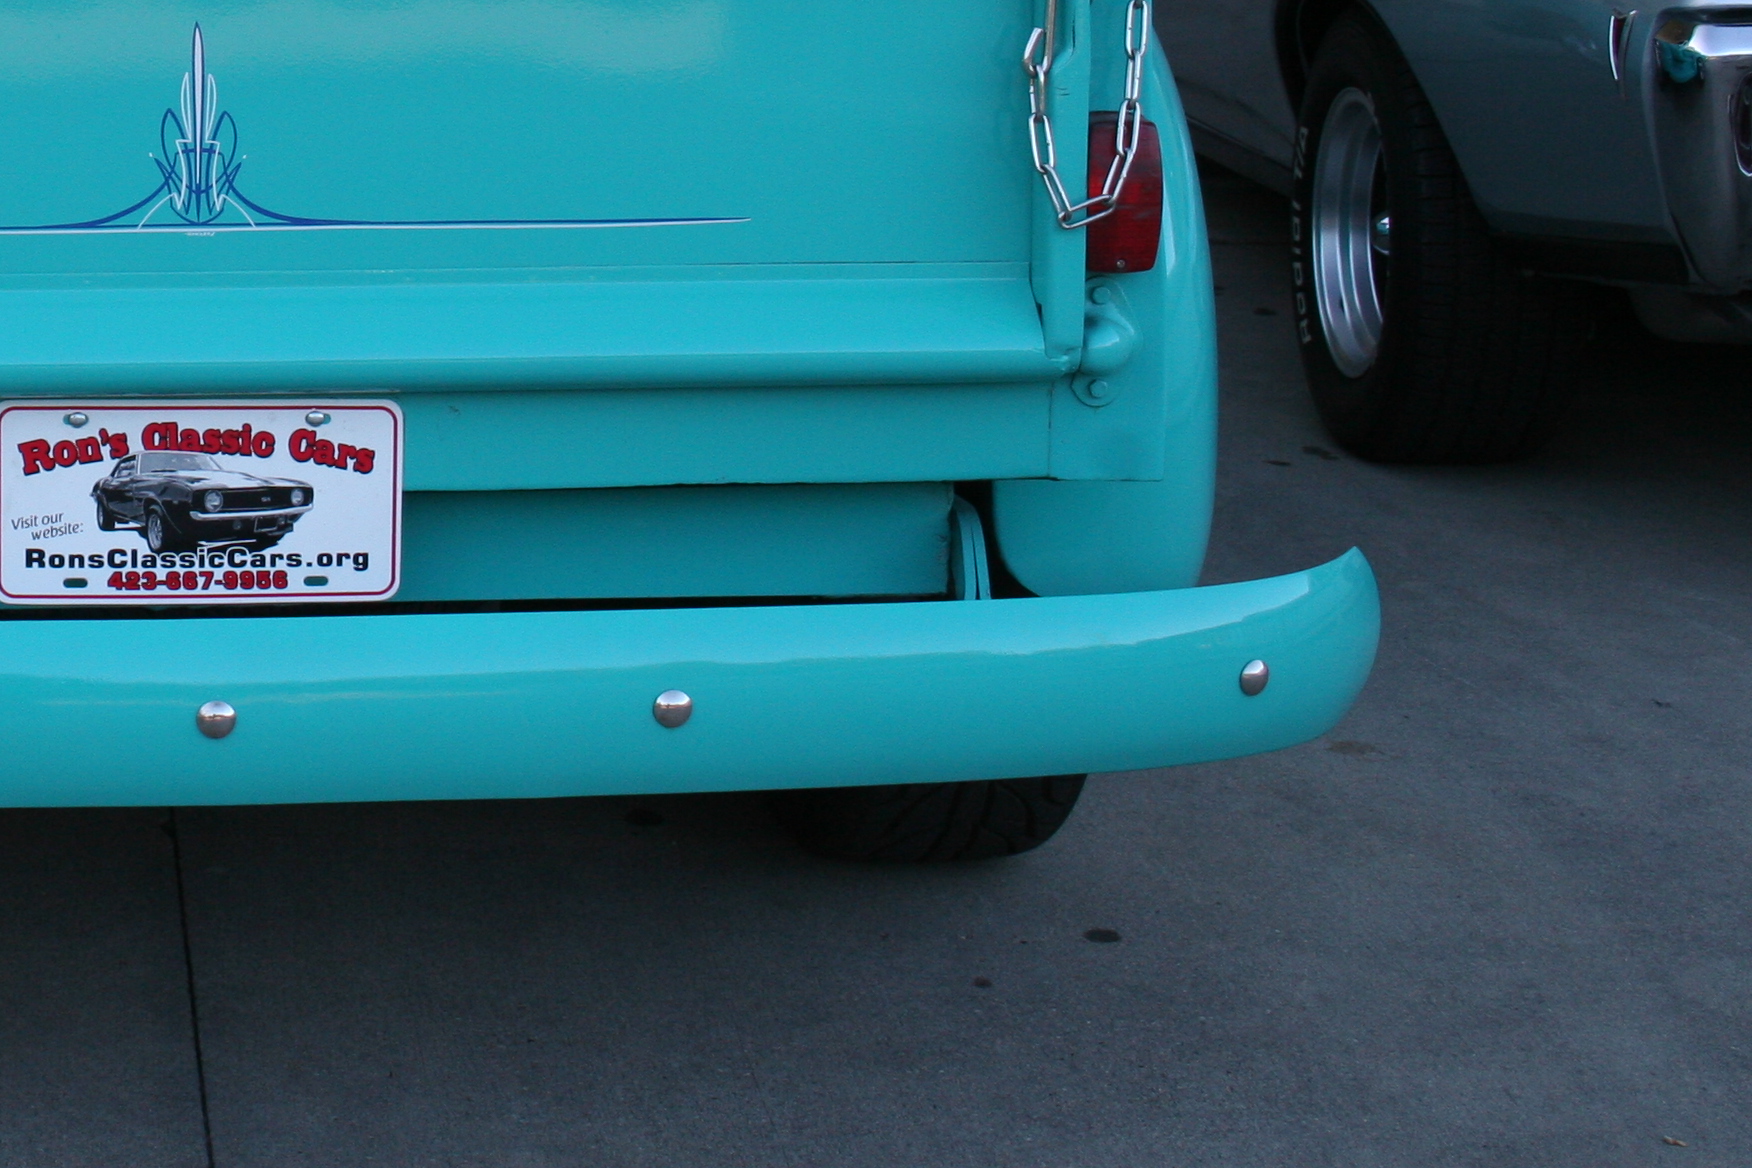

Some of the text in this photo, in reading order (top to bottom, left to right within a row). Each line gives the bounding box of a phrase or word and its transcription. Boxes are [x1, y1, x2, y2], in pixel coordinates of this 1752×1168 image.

[17, 421, 375, 476] Ron's Classic Cars
[11, 512, 64, 531] Visit our
[31, 523, 84, 541] website:
[25, 547, 369, 571] RonsClassicCars.org
[107, 570, 289, 591] 423-667-9956
